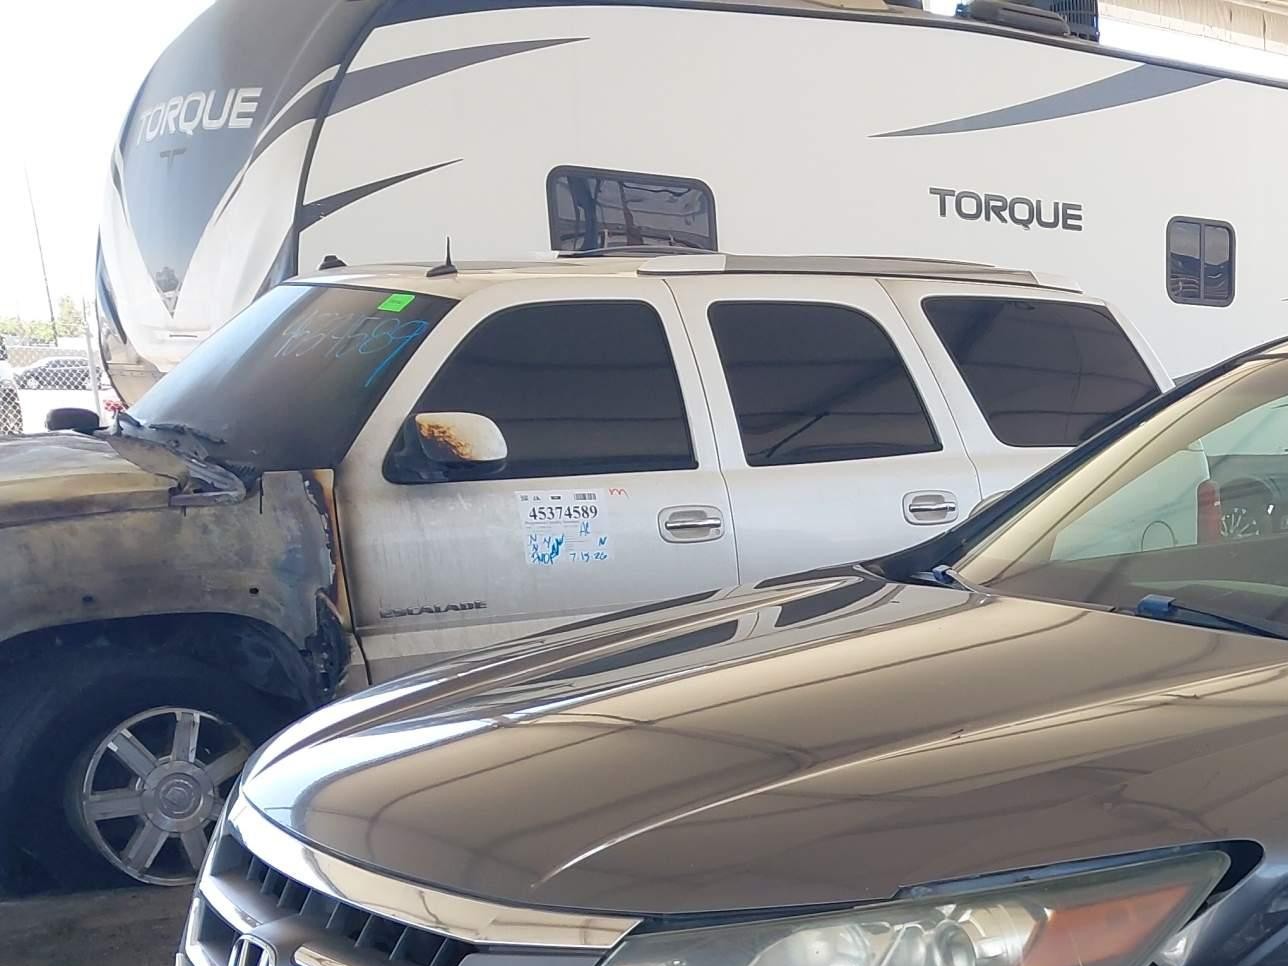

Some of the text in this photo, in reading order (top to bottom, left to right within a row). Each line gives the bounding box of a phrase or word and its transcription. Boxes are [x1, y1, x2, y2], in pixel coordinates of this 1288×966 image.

[136, 87, 262, 145] TORQUE
[928, 187, 1083, 231] TORQUE
[529, 504, 598, 520] 45374589
[379, 599, 487, 619] ESCALADE
